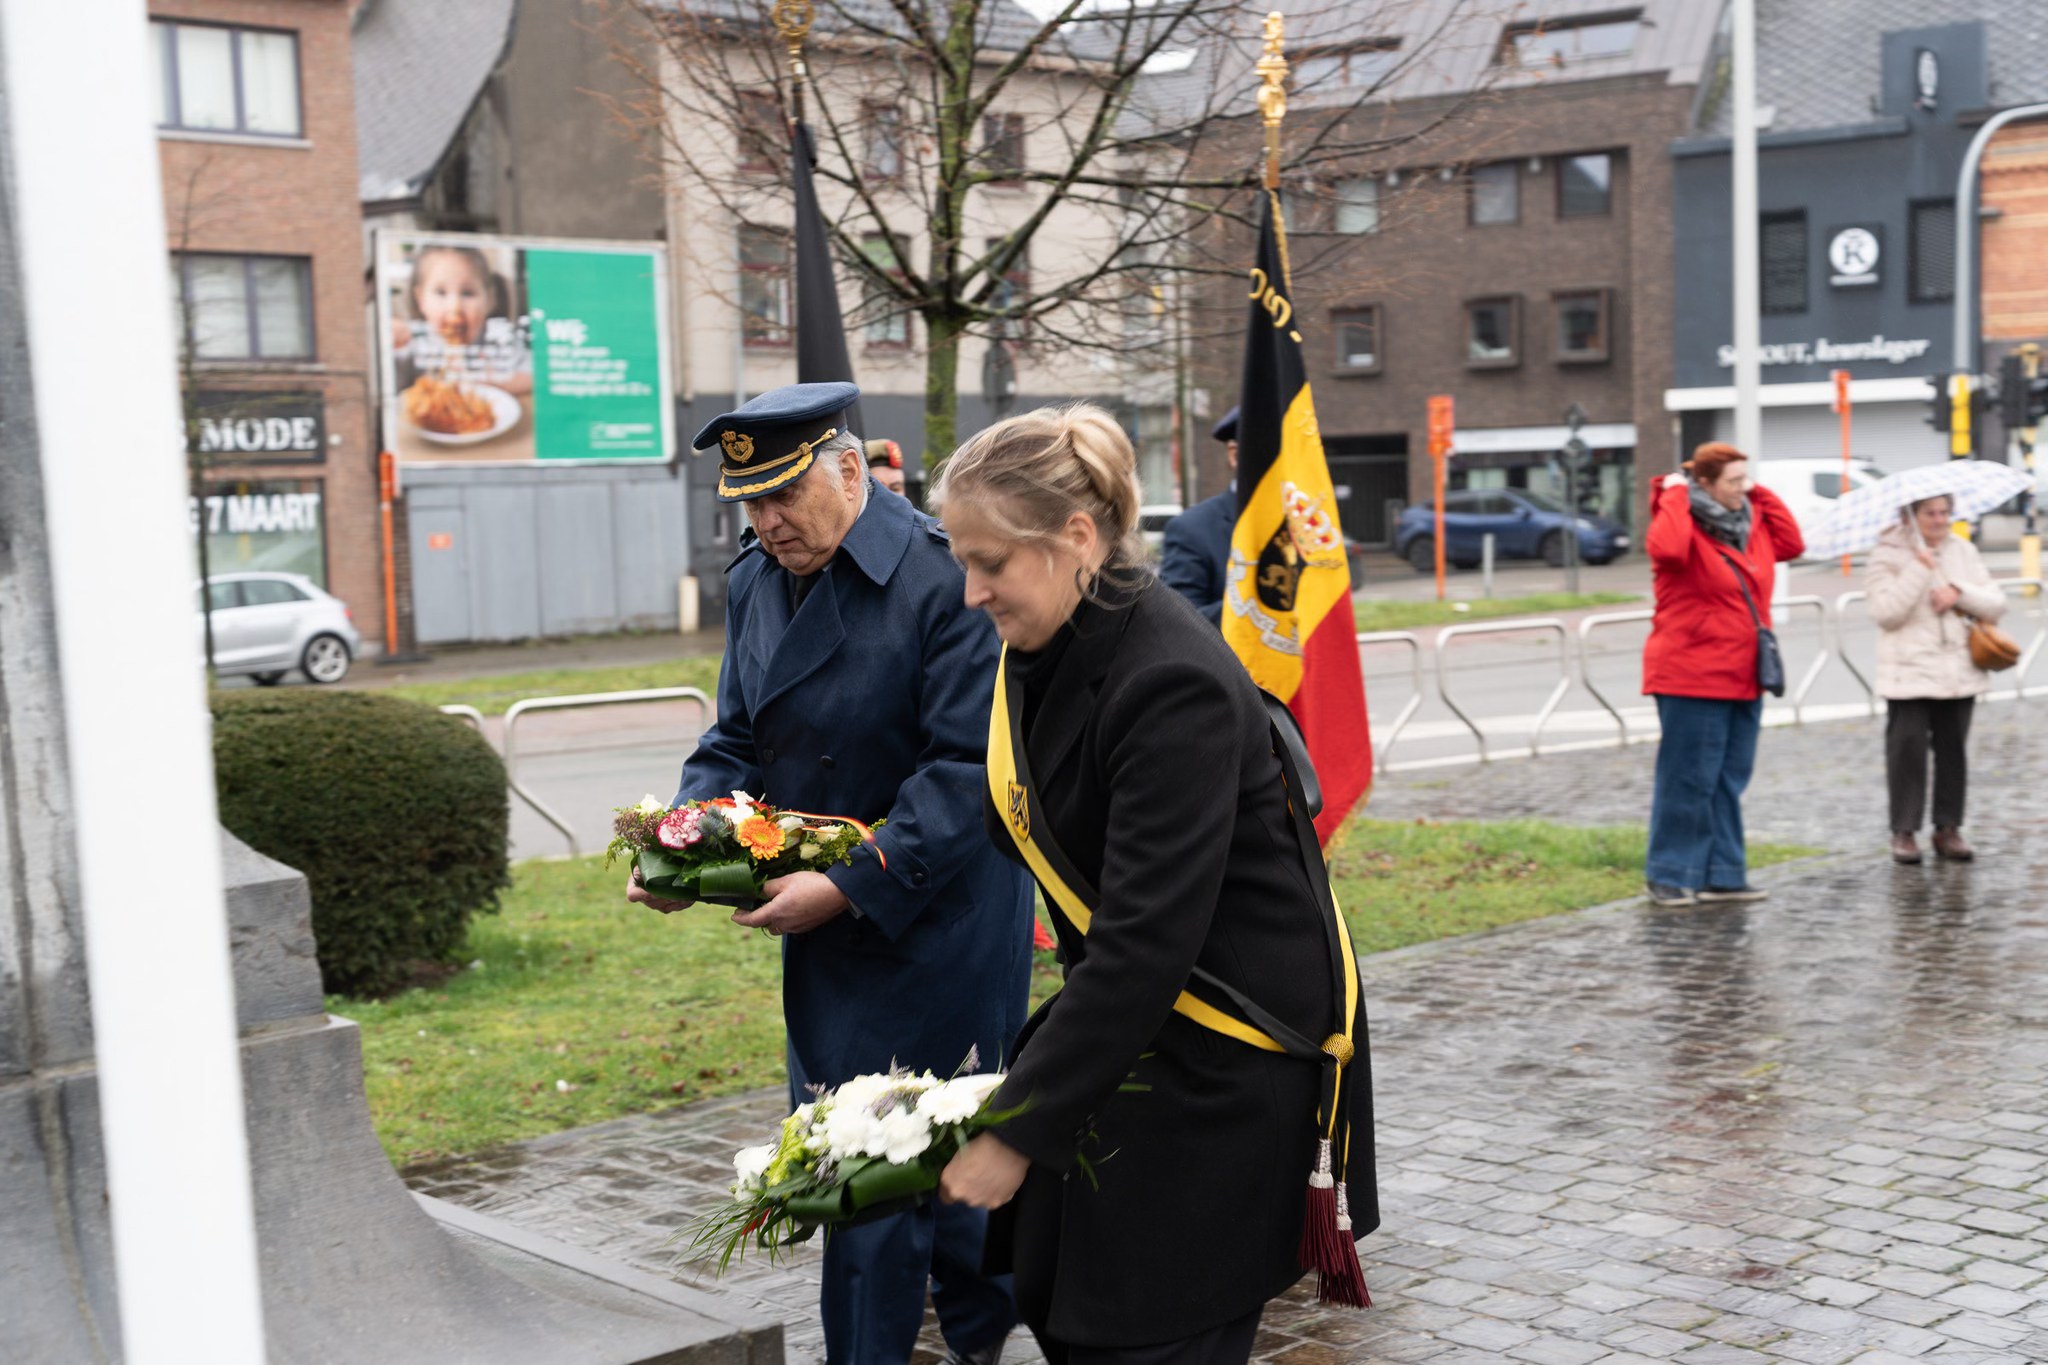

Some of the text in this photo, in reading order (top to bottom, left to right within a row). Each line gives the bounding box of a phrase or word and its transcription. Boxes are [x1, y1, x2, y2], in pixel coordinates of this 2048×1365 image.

[198, 416, 318, 452] MODE
[204, 495, 224, 534] 7
[226, 492, 321, 534] MAART
